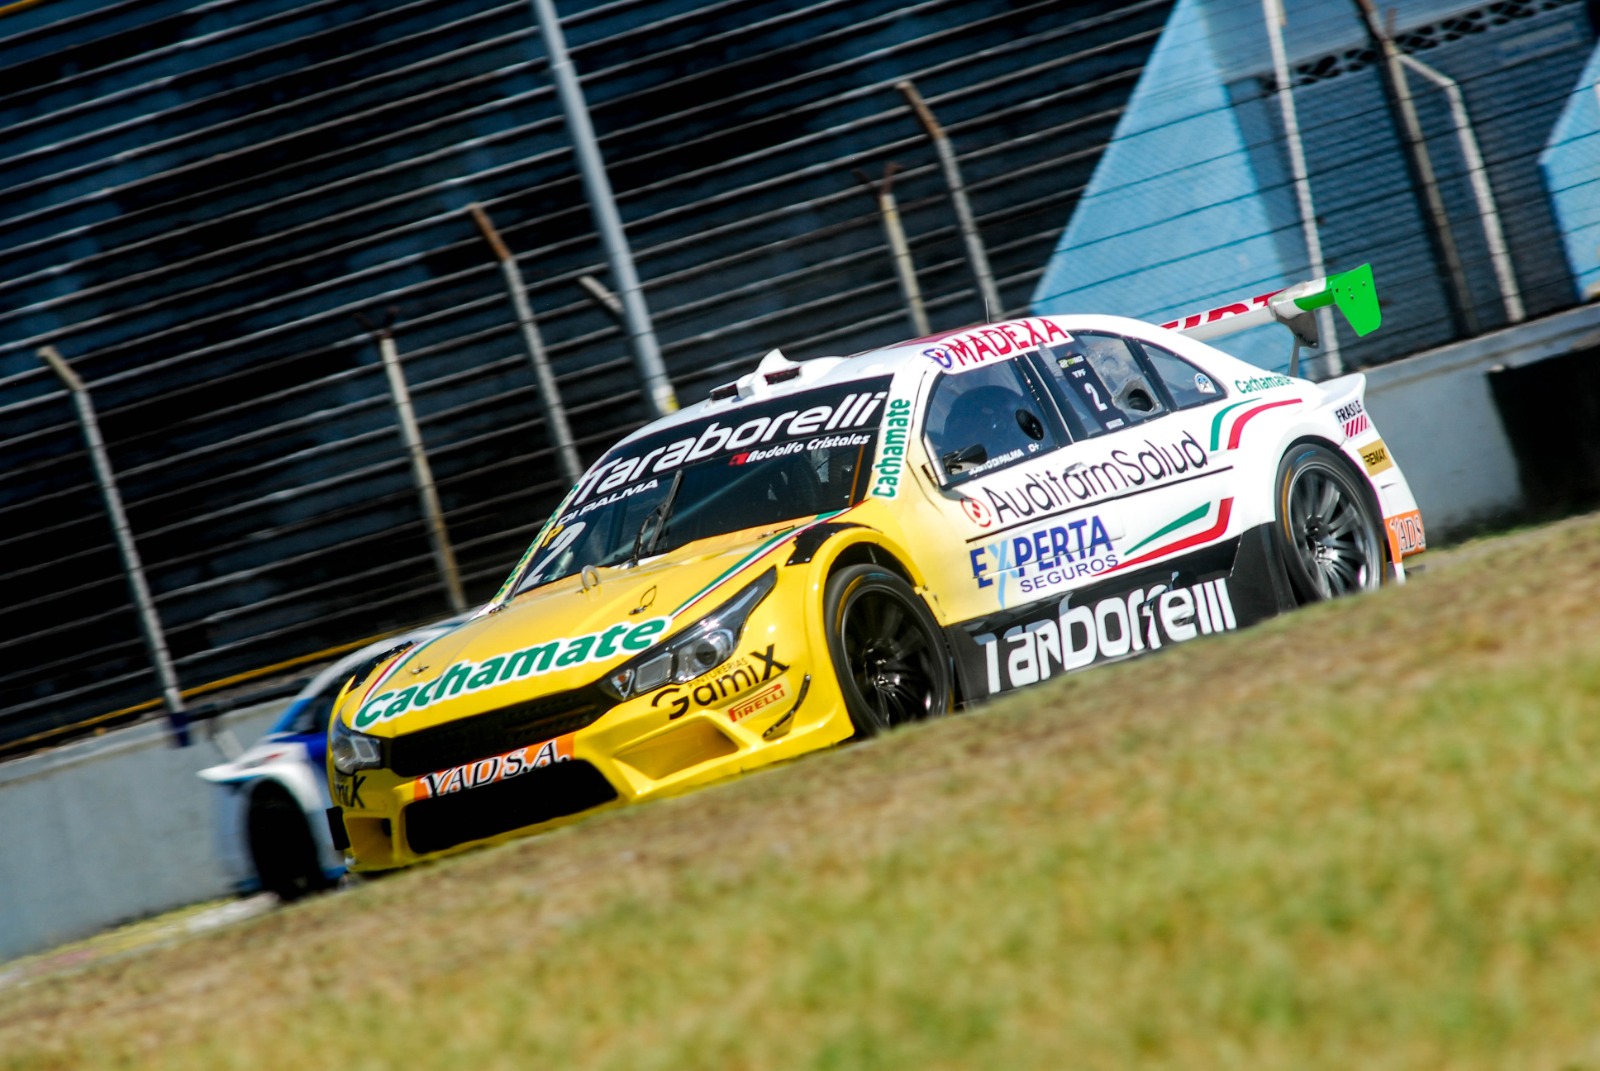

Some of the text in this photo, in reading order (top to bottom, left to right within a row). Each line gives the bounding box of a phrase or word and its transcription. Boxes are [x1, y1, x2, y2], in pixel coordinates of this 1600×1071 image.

[941, 318, 1068, 366] MADEXA
[1084, 382, 1108, 411] 2
[573, 391, 888, 506] Taraborelli
[745, 433, 871, 463] Rodolfo Cristales
[556, 479, 659, 526] DI PALMA
[516, 521, 587, 594] 2
[970, 515, 1114, 606] EXPERTA
[1020, 554, 1118, 593] SEGUROS
[728, 683, 785, 723] PIRELLI
